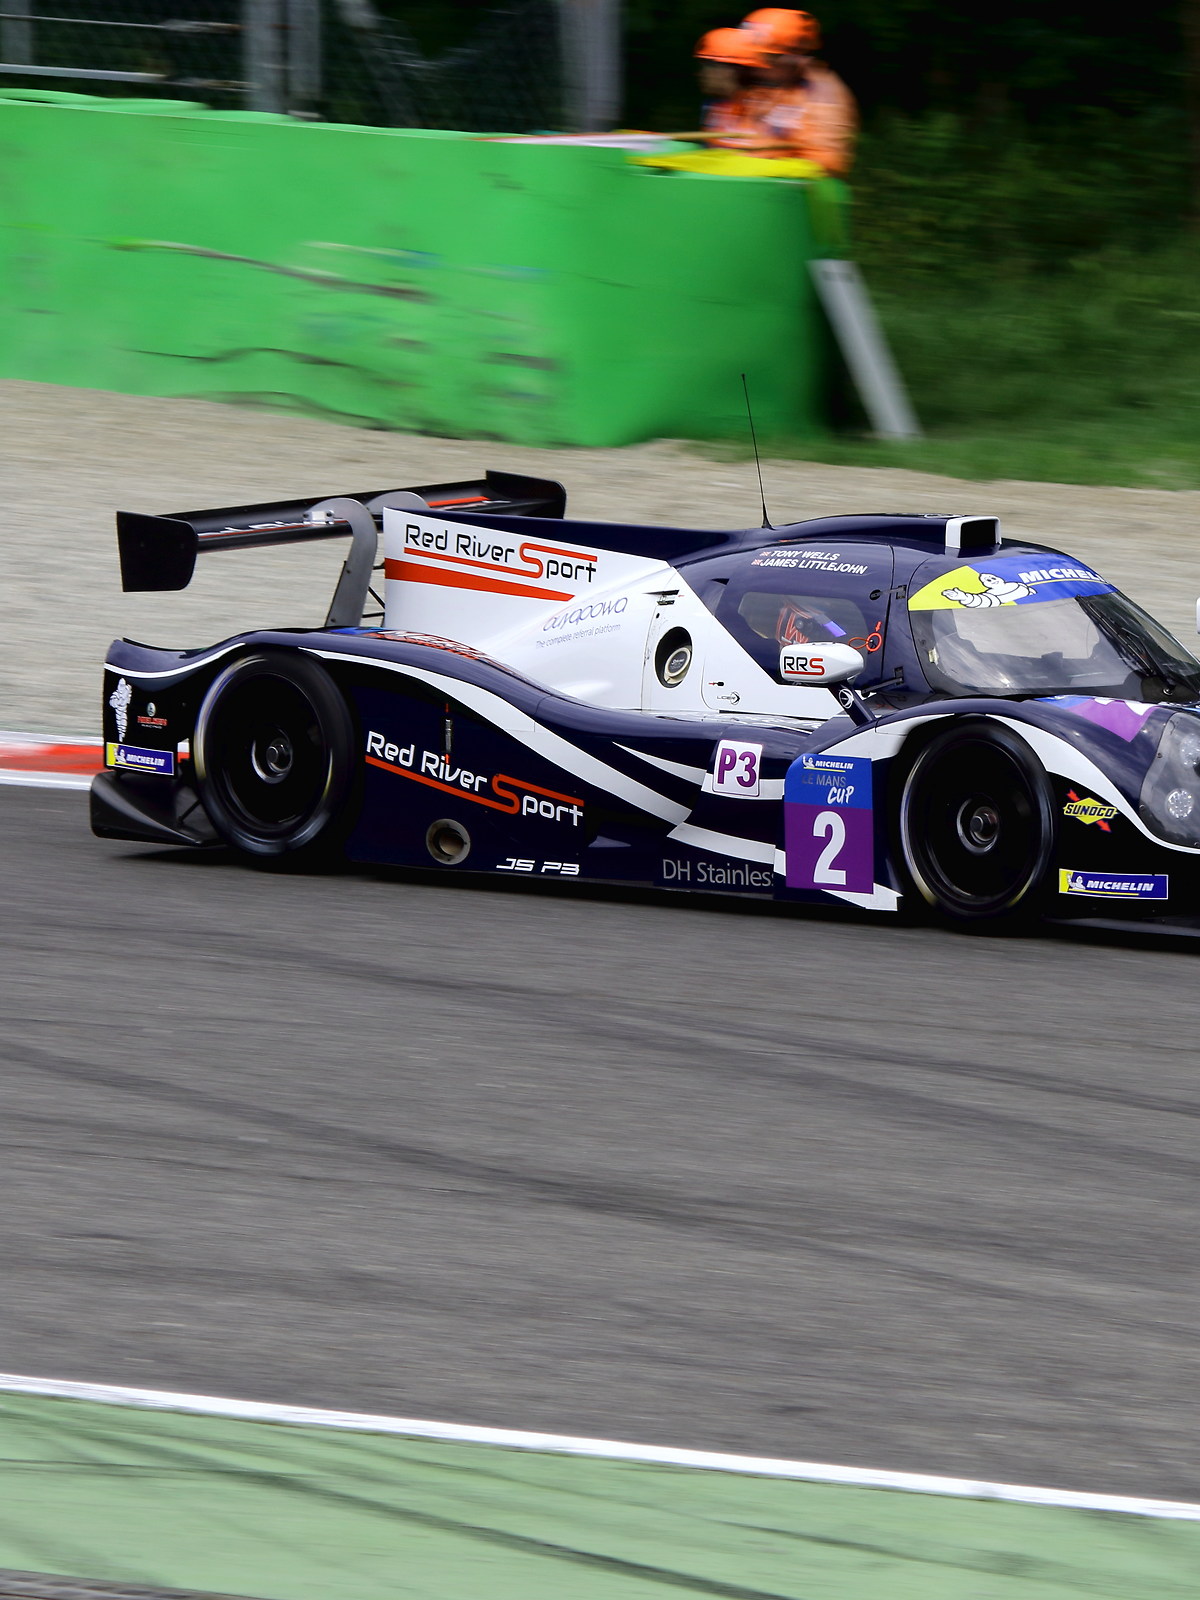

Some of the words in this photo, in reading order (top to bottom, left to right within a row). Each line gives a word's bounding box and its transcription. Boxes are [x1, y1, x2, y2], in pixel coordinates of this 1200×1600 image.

[405, 523, 448, 551] Red
[456, 533, 515, 562] River
[519, 542, 598, 582] Sport
[771, 550, 801, 558] TONY
[801, 551, 840, 561] WELLS
[760, 558, 798, 567] JAMES
[798, 559, 868, 575] LITTLEJOHN
[546, 633, 572, 646] complete
[572, 627, 593, 640] referral
[594, 623, 621, 637] platform
[783, 656, 825, 675] RRS
[126, 753, 165, 766] MICHELIN
[717, 747, 757, 787] P3
[815, 760, 854, 770] MICHELIN
[366, 730, 415, 767] Red
[420, 750, 488, 791] River
[491, 773, 585, 826] Sport
[802, 773, 816, 785] LE
[816, 775, 847, 787] MANS
[827, 785, 855, 804] CUP
[1065, 803, 1117, 818] SUNOCO
[812, 810, 847, 885] 2
[541, 860, 580, 875] P3
[662, 858, 691, 881] DH
[696, 861, 774, 887] Stainles
[1086, 880, 1154, 891] MICHELIN
